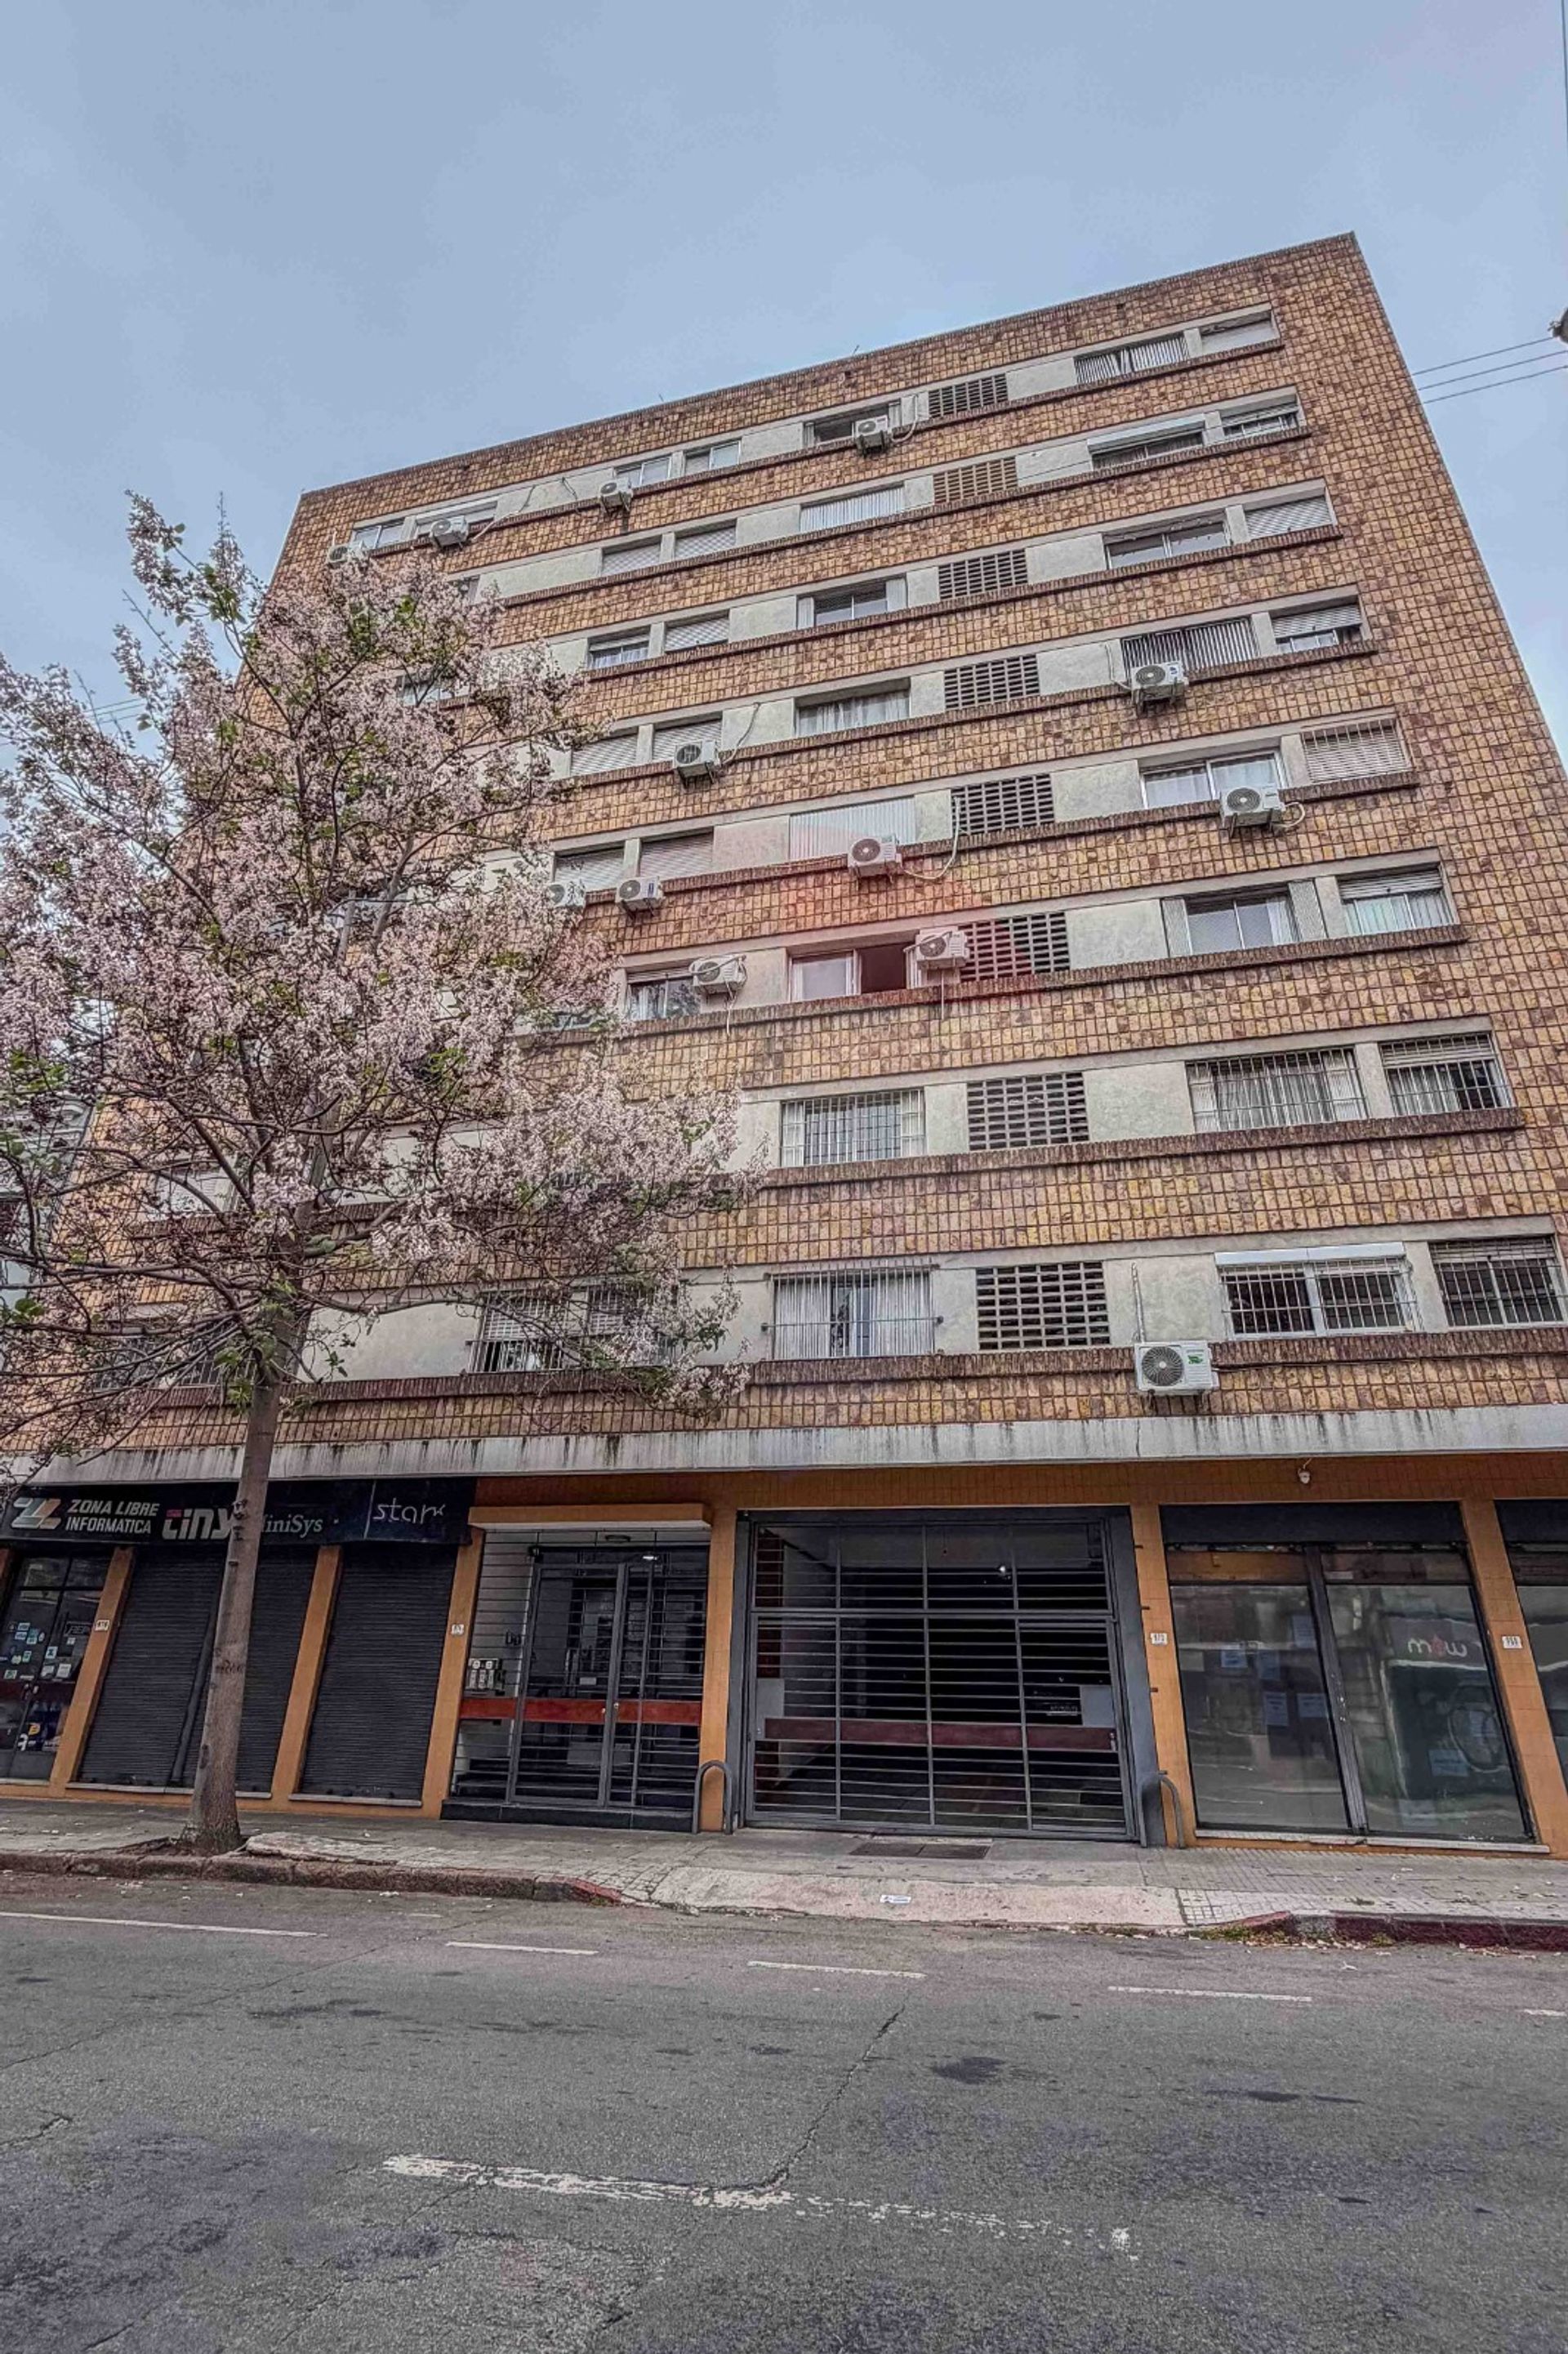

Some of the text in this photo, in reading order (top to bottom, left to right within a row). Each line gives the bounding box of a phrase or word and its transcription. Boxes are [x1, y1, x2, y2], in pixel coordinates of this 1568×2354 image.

[67, 1499, 160, 1517] ZONA LIBRE
[65, 1517, 152, 1534] INFORMATICA
[262, 1514, 323, 1539] iniSys
